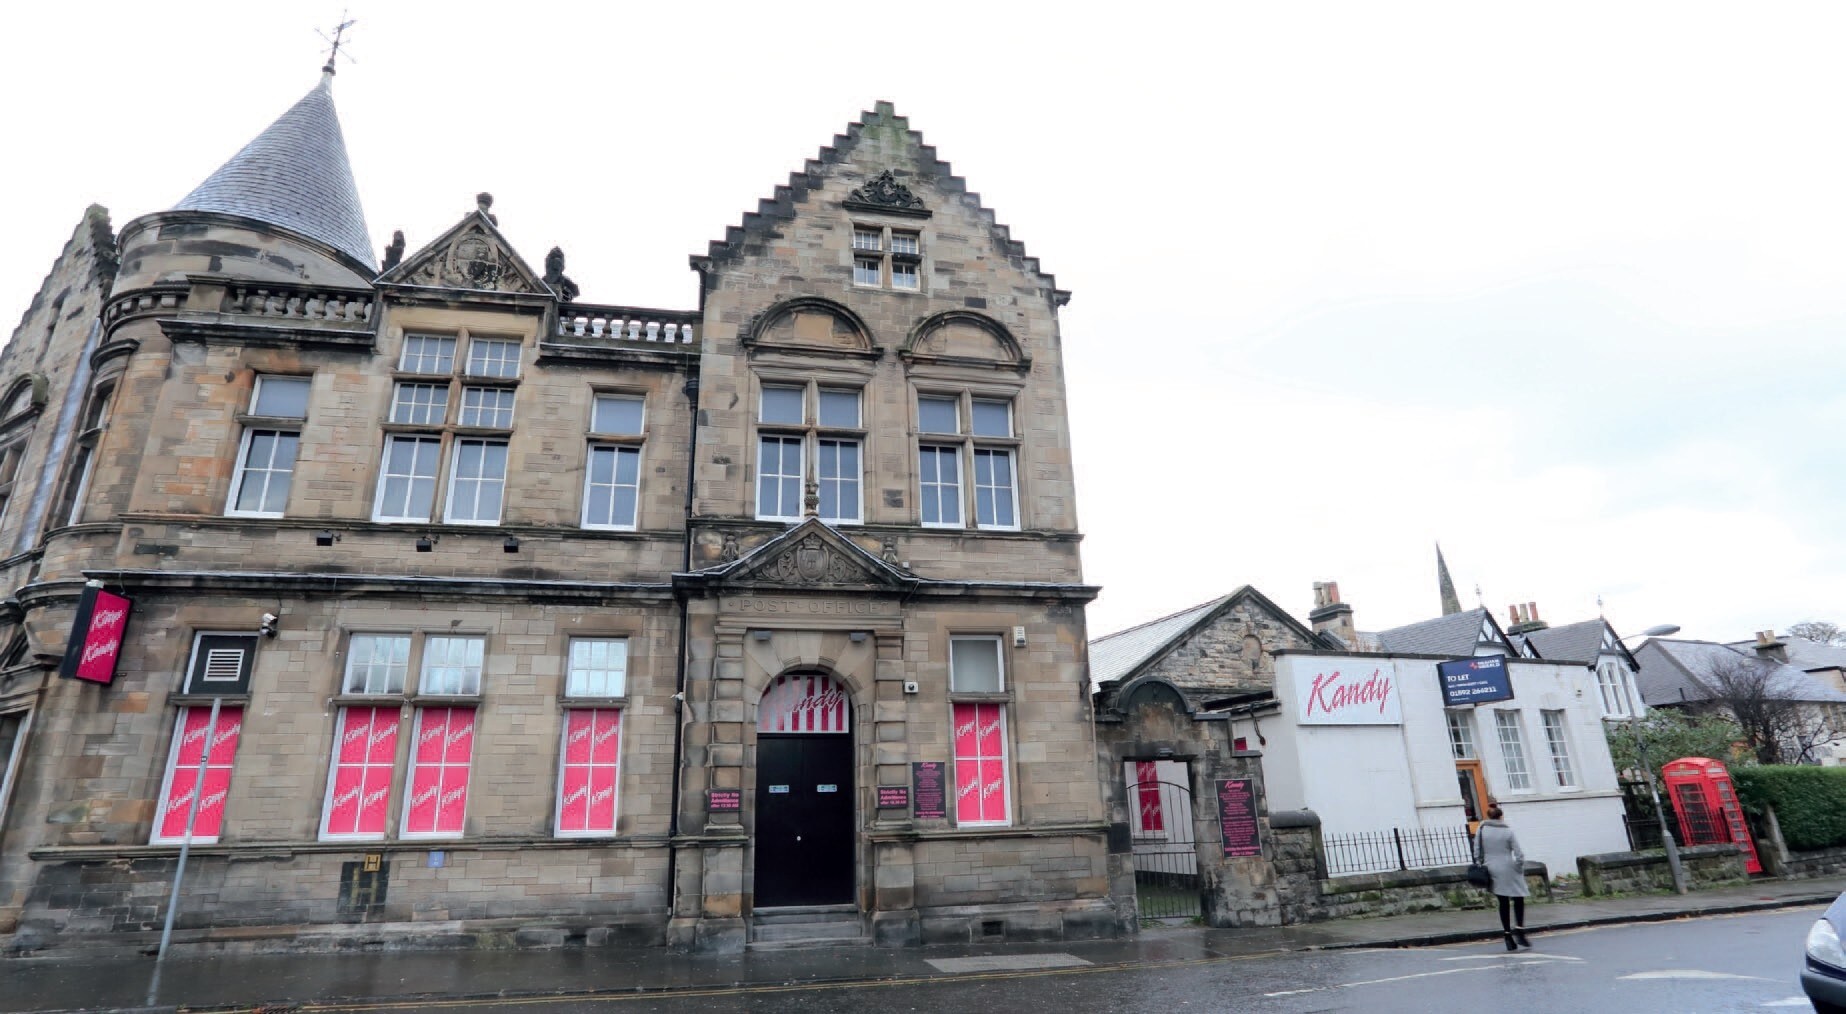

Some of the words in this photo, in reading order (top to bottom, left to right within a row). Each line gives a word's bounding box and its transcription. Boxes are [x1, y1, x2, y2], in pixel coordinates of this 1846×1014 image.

[740, 599, 794, 612] POST
[808, 600, 878, 614] OFFICE
[1307, 668, 1393, 717] Kandy
[367, 855, 379, 869] H
[350, 866, 378, 910] H
